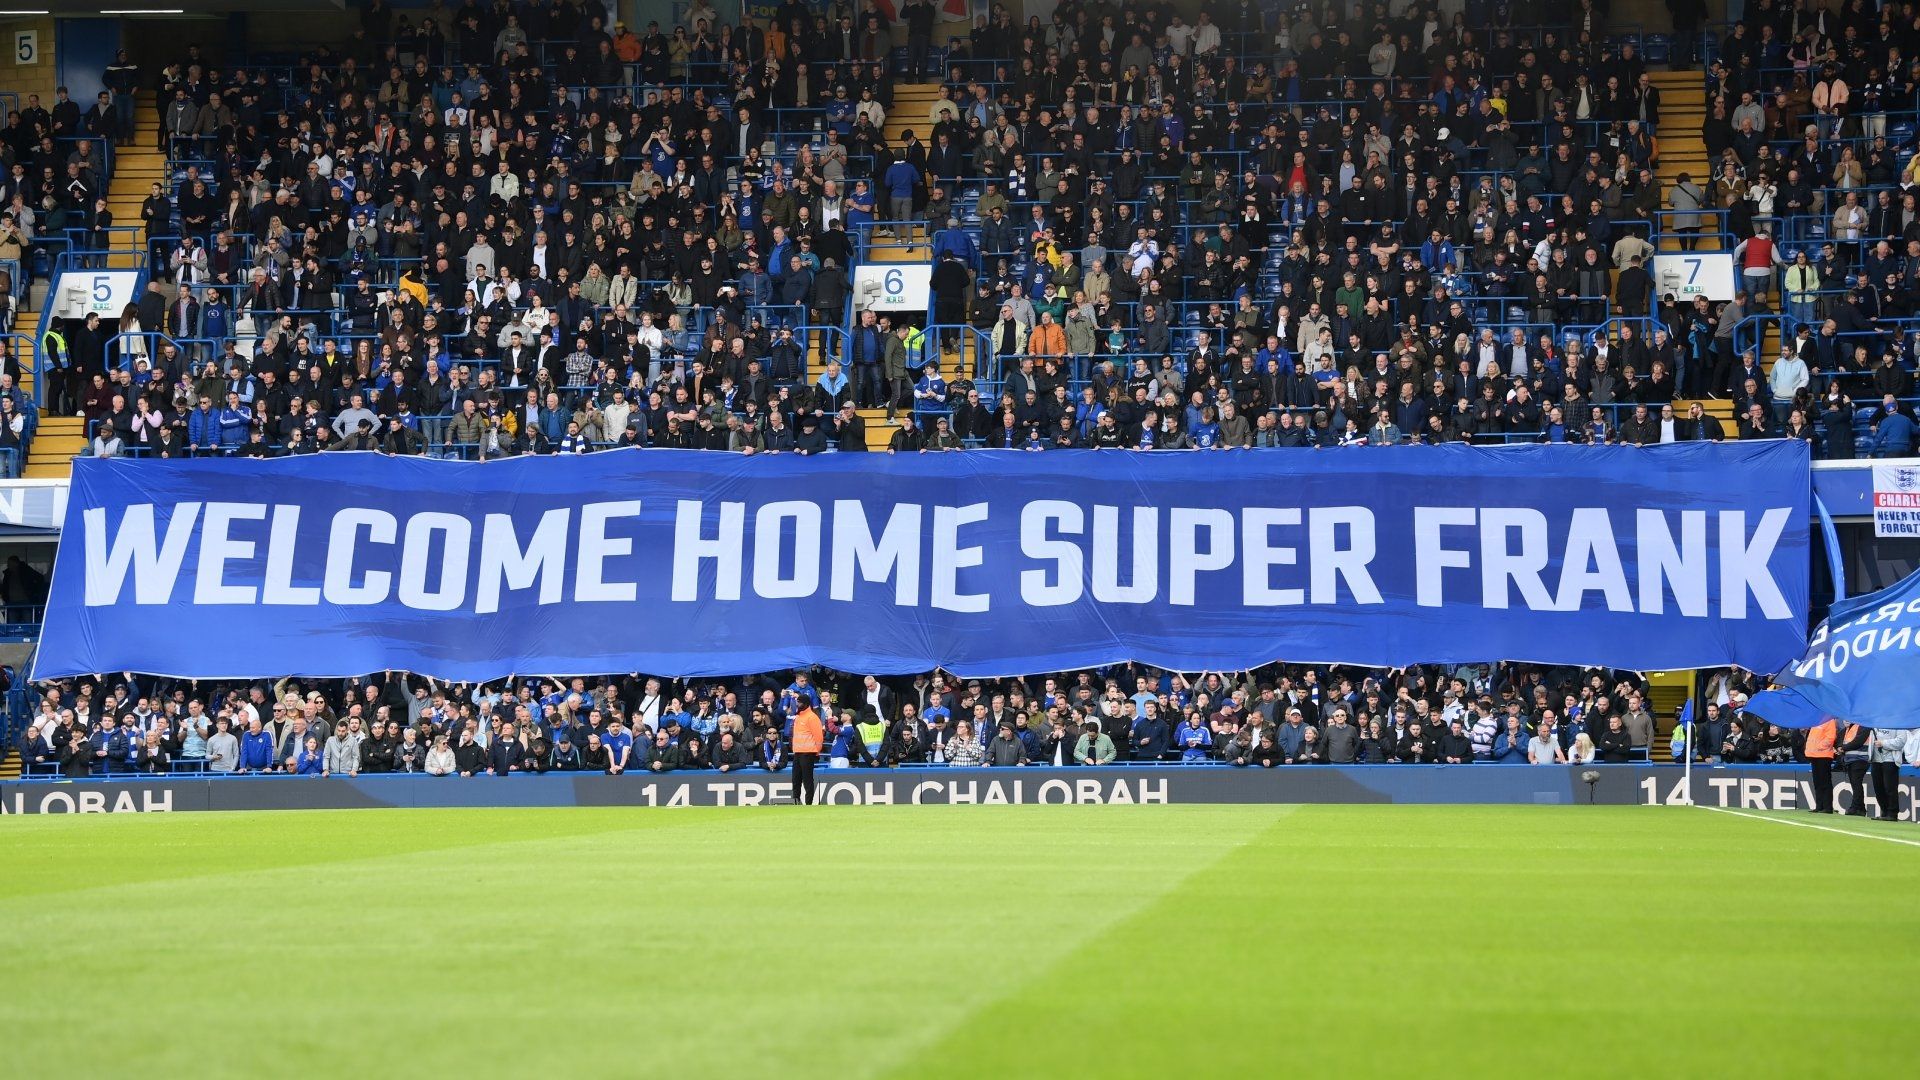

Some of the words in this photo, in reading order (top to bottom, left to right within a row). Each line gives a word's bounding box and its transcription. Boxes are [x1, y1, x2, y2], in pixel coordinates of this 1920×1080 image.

[19, 36, 33, 61] 5
[885, 269, 904, 295] 6
[1684, 259, 1702, 284] 7
[93, 276, 112, 302] 5
[1877, 511, 1907, 521] NEVER
[1881, 523, 1920, 534] FORGOT
[84, 500, 641, 614] WELCOME
[671, 499, 990, 613] HOME
[1020, 499, 1385, 608] SUPER
[1414, 506, 1794, 620] FRANK
[0, 789, 173, 815] LOBAH
[641, 783, 693, 808] 14
[1640, 776, 1694, 806] 14
